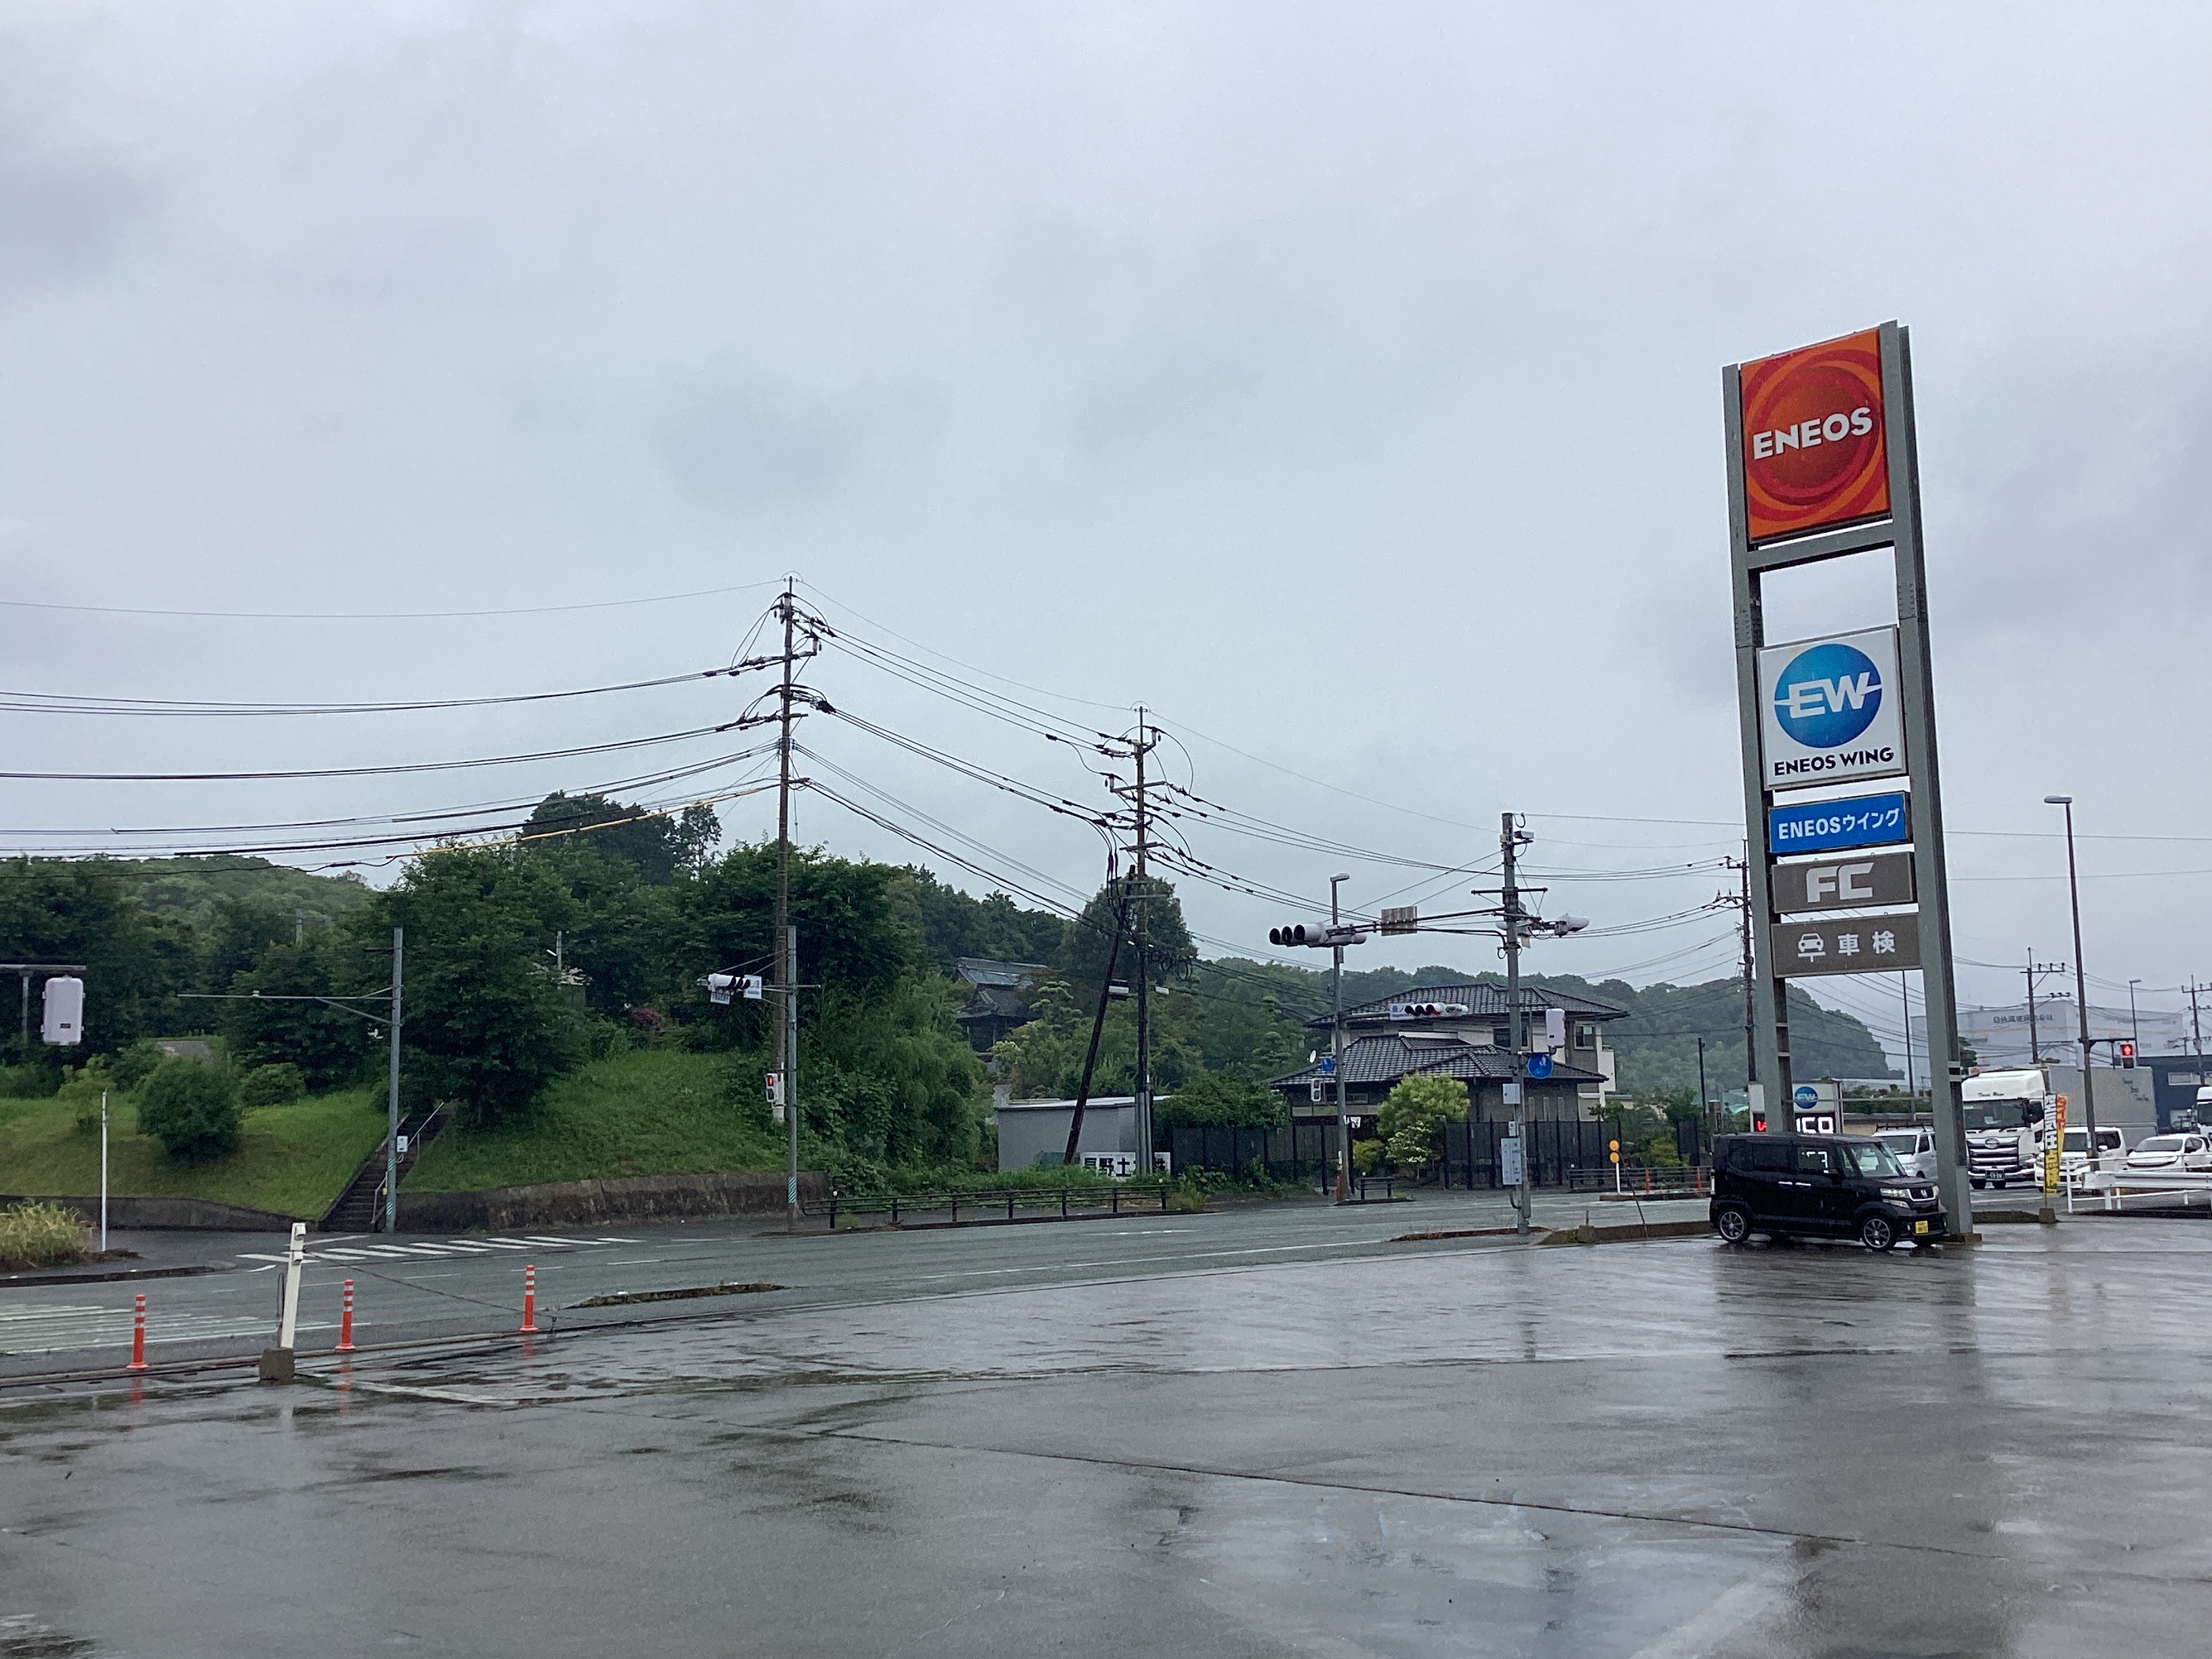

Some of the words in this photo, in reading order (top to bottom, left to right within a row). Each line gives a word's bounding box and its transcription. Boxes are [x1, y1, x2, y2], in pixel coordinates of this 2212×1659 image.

[1753, 407, 1872, 459] ENEOS
[1788, 672, 1871, 719] EW
[1774, 754, 1837, 776] ENEOS
[1839, 747, 1894, 767] WING
[1778, 808, 1900, 840] ENEOSウイング
[1806, 862, 1875, 903] FC
[1837, 930, 1896, 956] 車検
